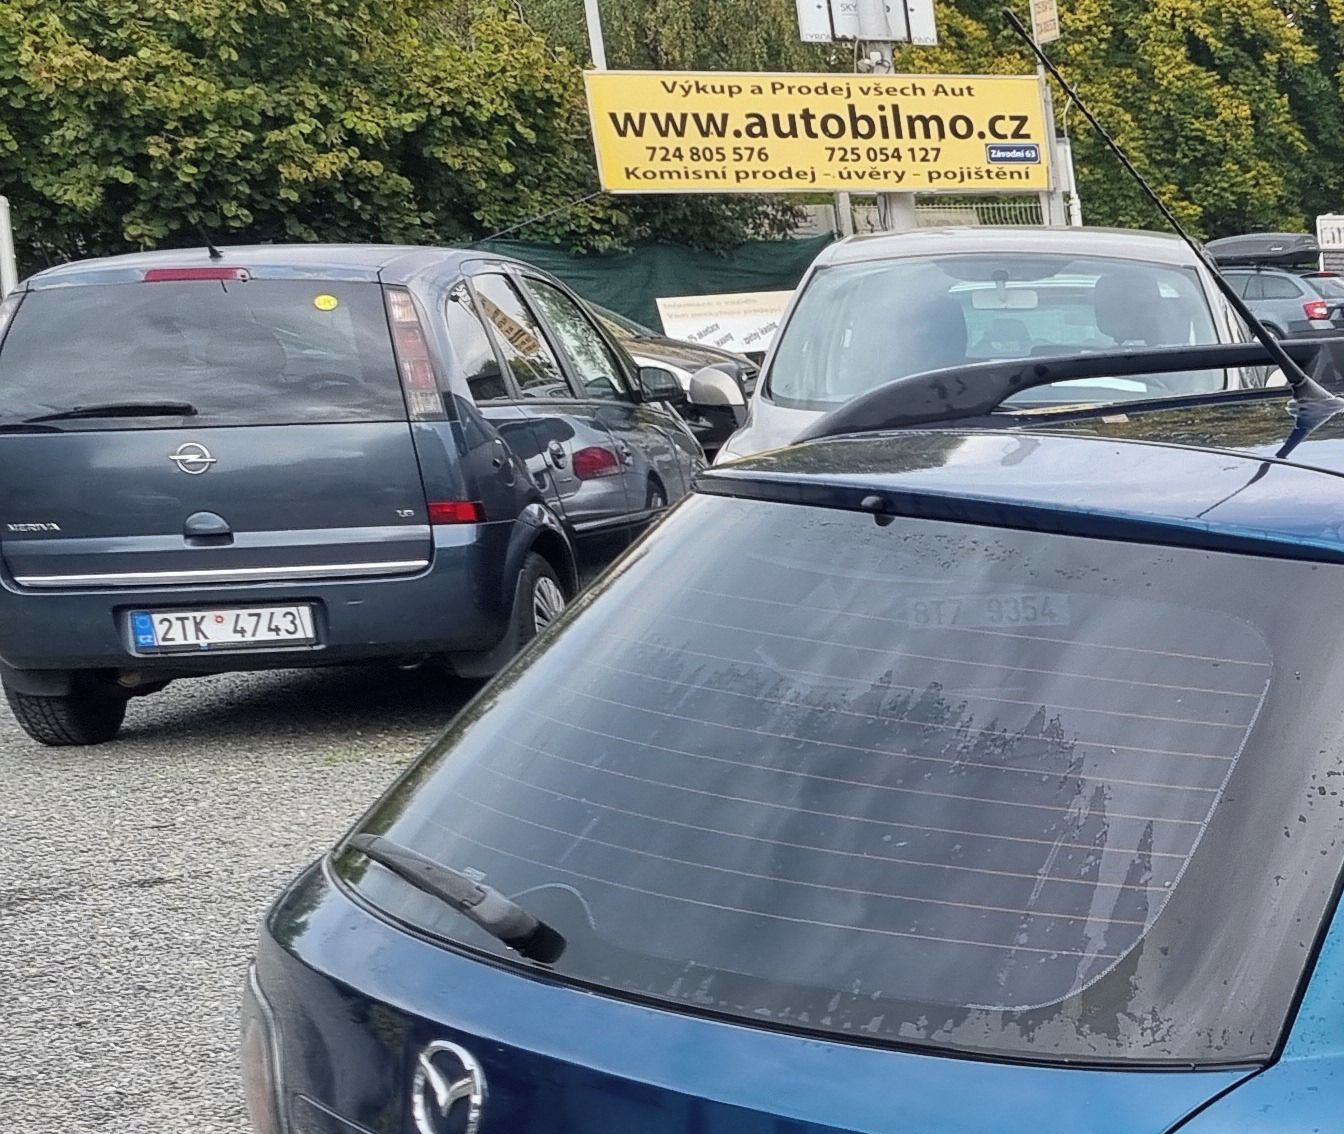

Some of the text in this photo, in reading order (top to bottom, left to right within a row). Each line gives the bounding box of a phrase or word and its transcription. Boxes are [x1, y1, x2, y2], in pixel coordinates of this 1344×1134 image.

[661, 80, 975, 99] Výkup a Prodej všech Aut
[608, 103, 1032, 141] www.autobilmo.cz
[645, 146, 769, 162] 724 805 576
[825, 147, 941, 162] 725 054 127
[624, 166, 727, 180] Komisní
[735, 166, 817, 183] prodej
[838, 167, 906, 183] úvěry
[928, 166, 1030, 183] pojištění
[159, 615, 210, 642] 2TK
[232, 611, 299, 638] 4743
